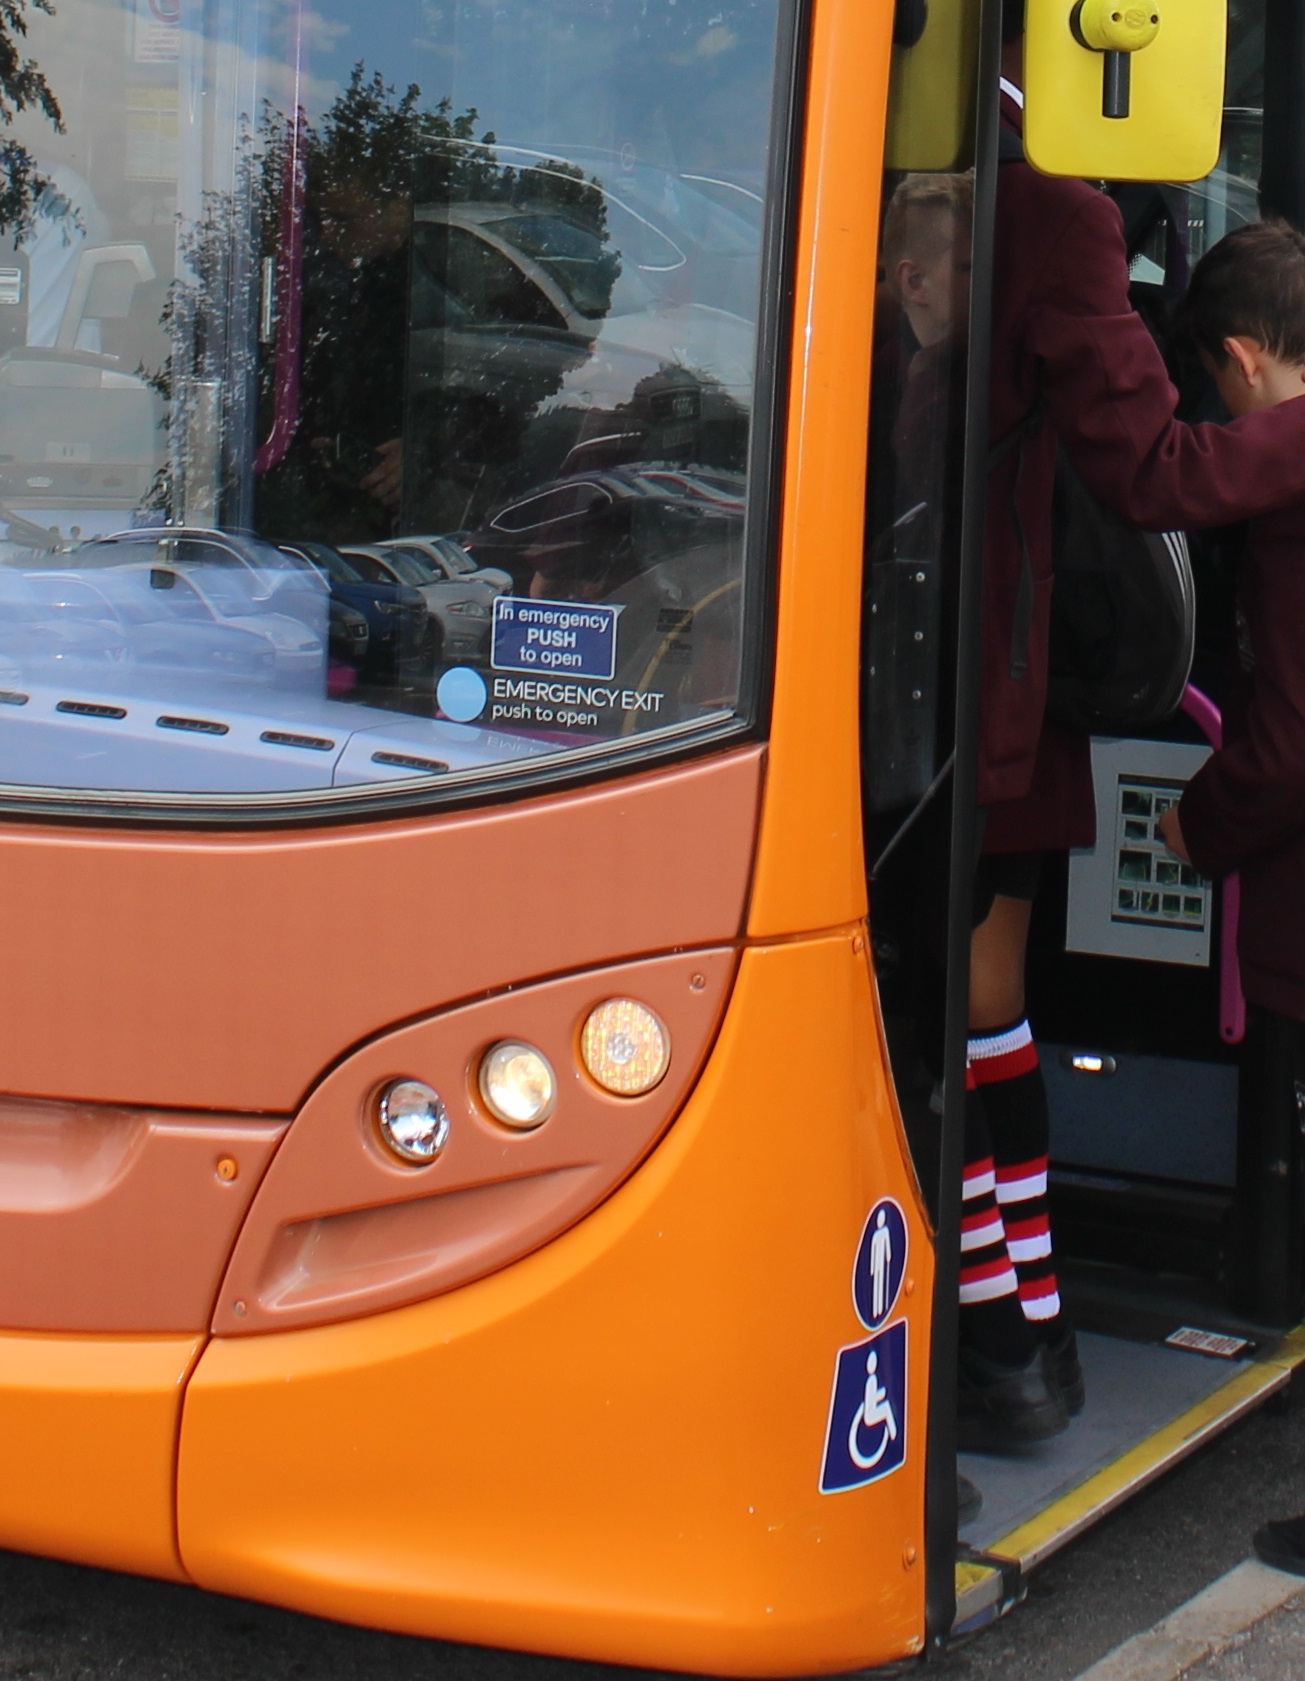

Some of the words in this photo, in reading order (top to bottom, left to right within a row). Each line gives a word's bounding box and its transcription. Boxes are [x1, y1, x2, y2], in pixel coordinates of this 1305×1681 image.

[499, 604, 514, 620] In
[518, 608, 609, 633] emergency
[527, 628, 576, 648] PUSH
[520, 646, 536, 662] to
[541, 651, 582, 667] open
[493, 678, 619, 708] EMERGENCY
[621, 691, 664, 712] EXIT
[492, 703, 531, 720] push
[535, 706, 553, 722] to
[557, 711, 597, 727] open
